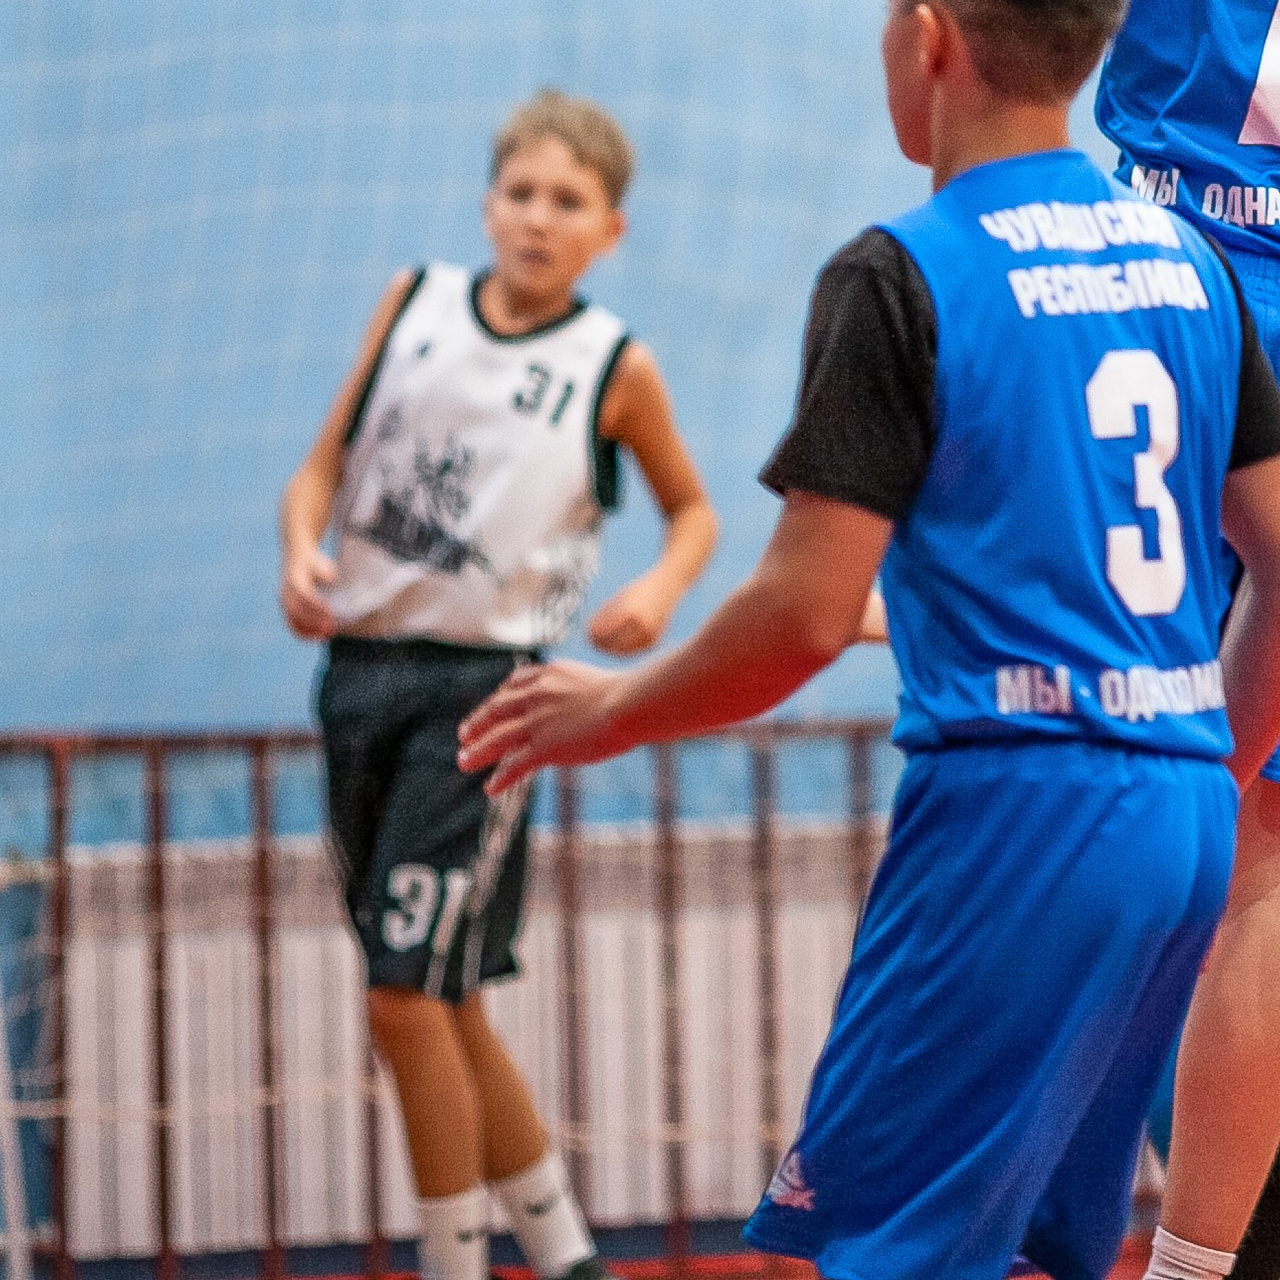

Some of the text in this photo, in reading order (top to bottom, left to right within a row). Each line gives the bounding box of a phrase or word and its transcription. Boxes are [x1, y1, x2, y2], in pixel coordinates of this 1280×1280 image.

[512, 363, 576, 428] 31
[1085, 349, 1187, 616] 3
[996, 664, 1072, 715] МЫ
[383, 862, 470, 955] 31
